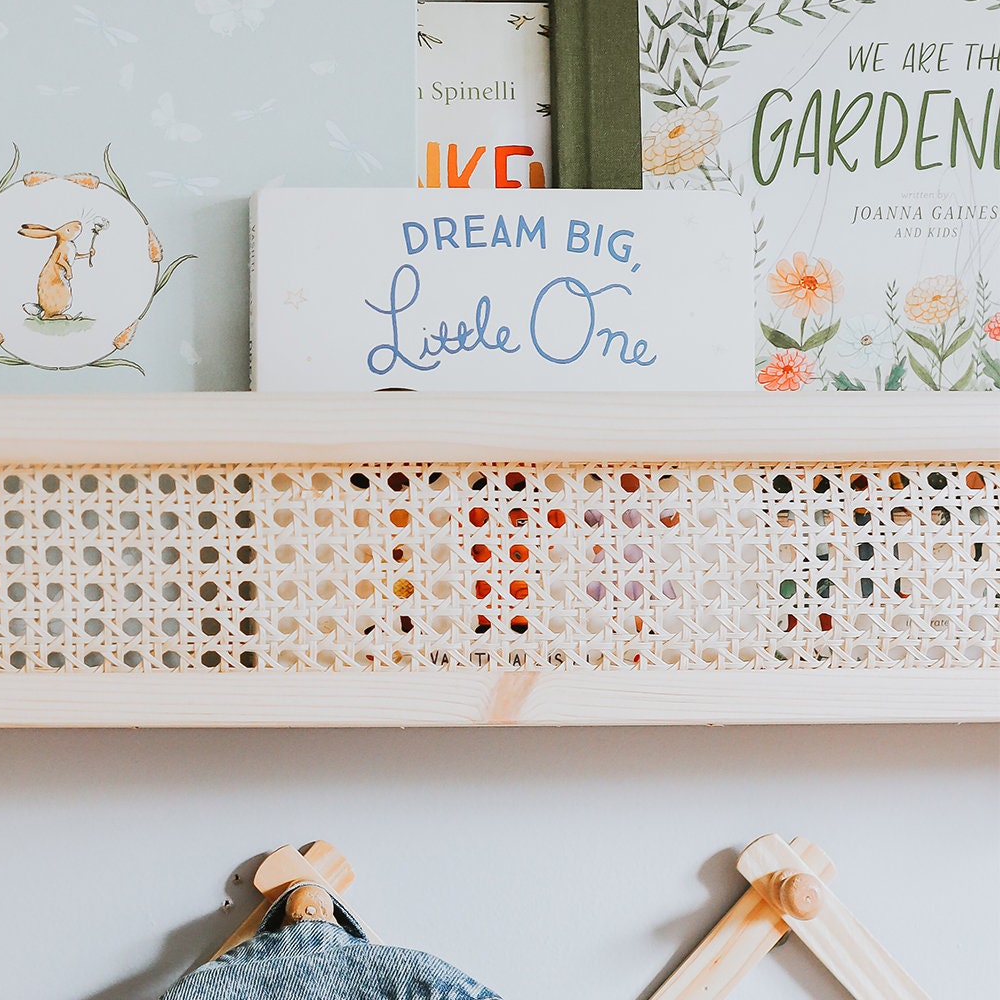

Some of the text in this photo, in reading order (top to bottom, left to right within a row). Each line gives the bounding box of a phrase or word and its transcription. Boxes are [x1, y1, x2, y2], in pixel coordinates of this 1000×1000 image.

[849, 42, 1000, 73] WE ARE TH
[432, 81, 516, 105] Spinelli
[752, 87, 1000, 187] GARDEN
[852, 205, 999, 224] JOANNA GAINES
[402, 214, 641, 273] DREAM BIG,
[894, 227, 958, 238] AND KIDS
[364, 263, 521, 375] Little
[530, 276, 657, 367] One
